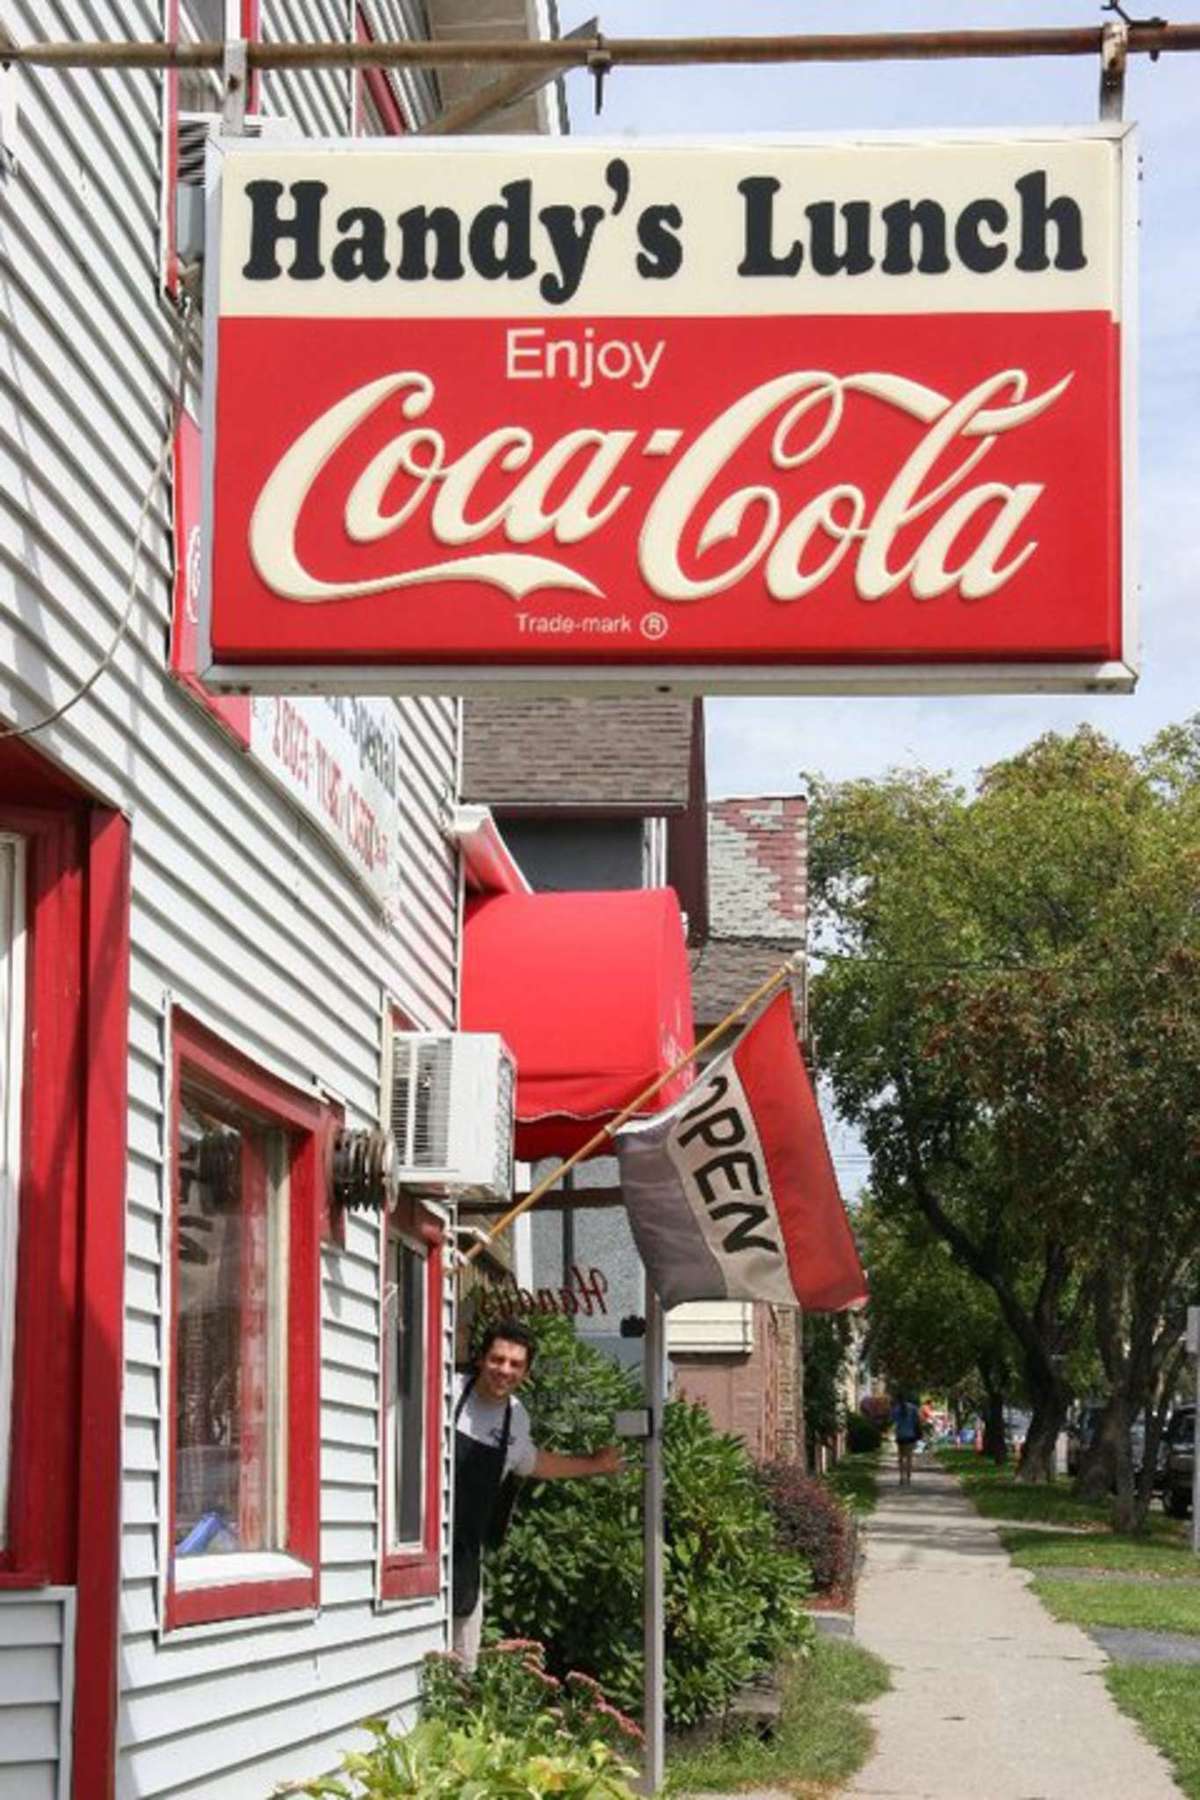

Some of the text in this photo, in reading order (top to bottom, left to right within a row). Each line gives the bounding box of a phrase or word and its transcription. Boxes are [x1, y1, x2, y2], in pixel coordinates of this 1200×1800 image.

[242, 158, 1088, 305] Handy's Lunch
[506, 327, 666, 390] Enjoy
[248, 368, 1075, 602] Coca-Cola
[515, 612, 632, 634] Trade-mark
